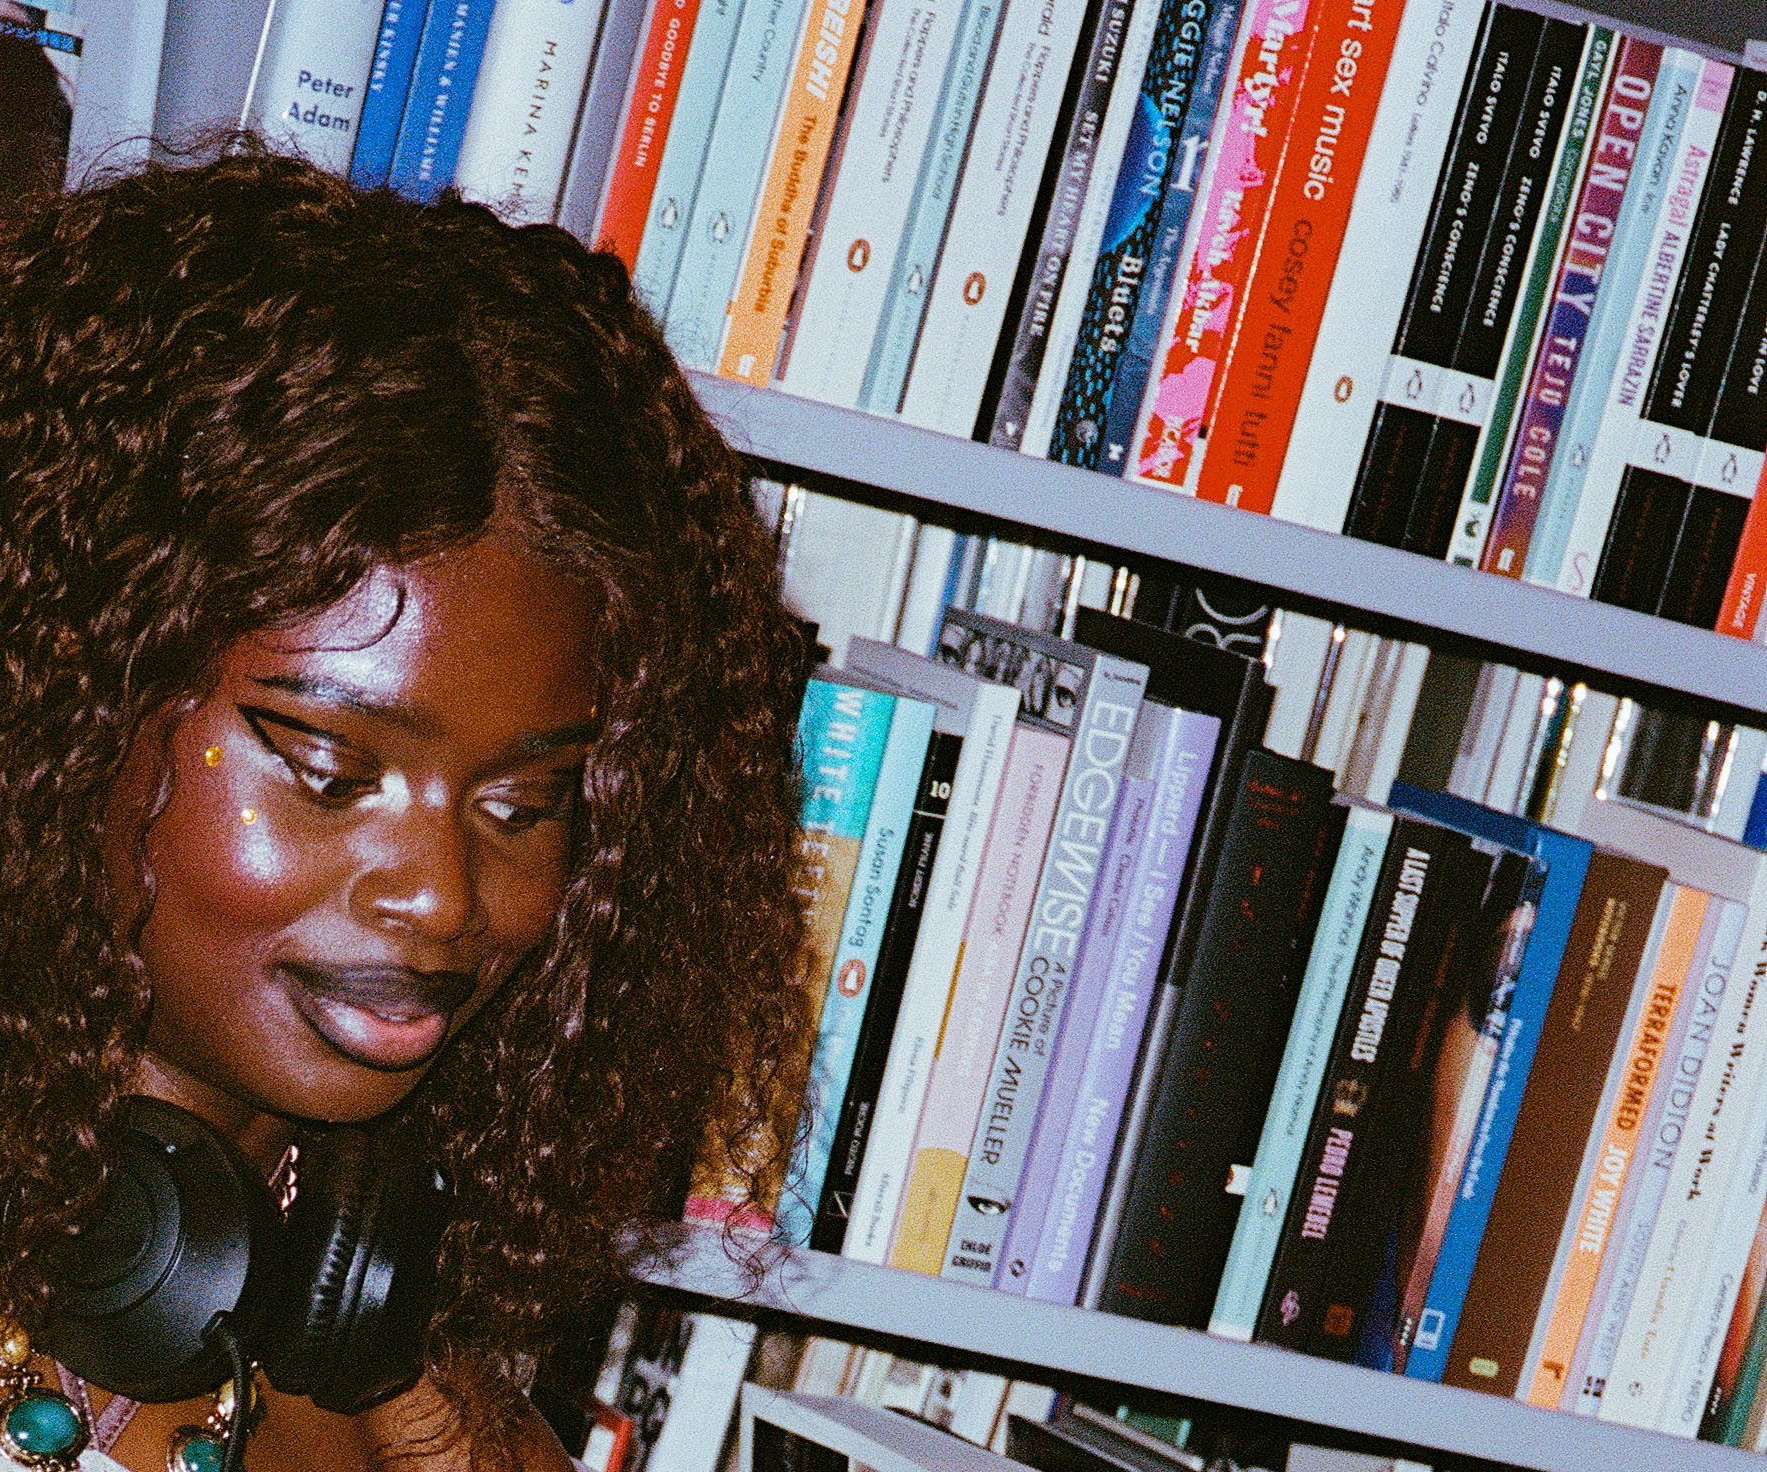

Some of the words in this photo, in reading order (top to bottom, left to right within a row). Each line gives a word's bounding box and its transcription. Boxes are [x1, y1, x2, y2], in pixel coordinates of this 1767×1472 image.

[654, 17, 681, 88] GOODBYE
[1490, 51, 1509, 93] ITALO
[297, 69, 355, 100] Peter
[648, 93, 663, 113] TO
[1543, 65, 1562, 107] ITALO
[287, 101, 351, 134] Adam
[634, 117, 656, 167] BERLIN
[797, 116, 818, 145] The
[1475, 96, 1498, 145] SVEVO
[1529, 110, 1551, 159] SVEVO
[1588, 71, 1652, 191] OPEN
[780, 149, 808, 214] Buddha
[1456, 161, 1480, 216] ZENO'S
[1509, 176, 1533, 231] ZENO'S
[775, 217, 788, 236] of
[754, 238, 786, 313] Suburbia
[1268, 218, 1314, 314] cosey
[1430, 219, 1464, 313] CONSCIENCE
[1483, 234, 1517, 327] CONSCIENCE
[1554, 207, 1616, 316] CITY
[1098, 252, 1145, 352] Bluets
[1250, 323, 1292, 400] fanni
[1538, 337, 1577, 406] TEJU
[1233, 410, 1268, 467] tutti
[1513, 425, 1552, 499] COLE
[869, 827, 896, 881] Susan
[1025, 699, 1135, 958] EDGEWISE
[1407, 848, 1430, 860] A
[1398, 859, 1427, 894] LAST
[847, 884, 882, 948] Sontag
[1384, 891, 1419, 942] SUPPER
[1368, 957, 1401, 1000] QUEER
[1380, 939, 1406, 960] OF
[1009, 955, 1050, 1051] COOKIE
[1351, 997, 1389, 1063] APOSTLES
[1690, 958, 1732, 1045] JOAN
[1616, 984, 1677, 1131] TERRAFORMED
[980, 1055, 1023, 1166] MUELLER
[1082, 1094, 1110, 1140] New
[1652, 1055, 1704, 1172] DIDION
[1319, 1127, 1353, 1176] PEDRO
[1599, 1143, 1629, 1187] JOY
[1044, 1149, 1097, 1273] Documents
[1301, 1176, 1339, 1239] LEMEBEL
[1579, 1189, 1616, 1254] WHITE
